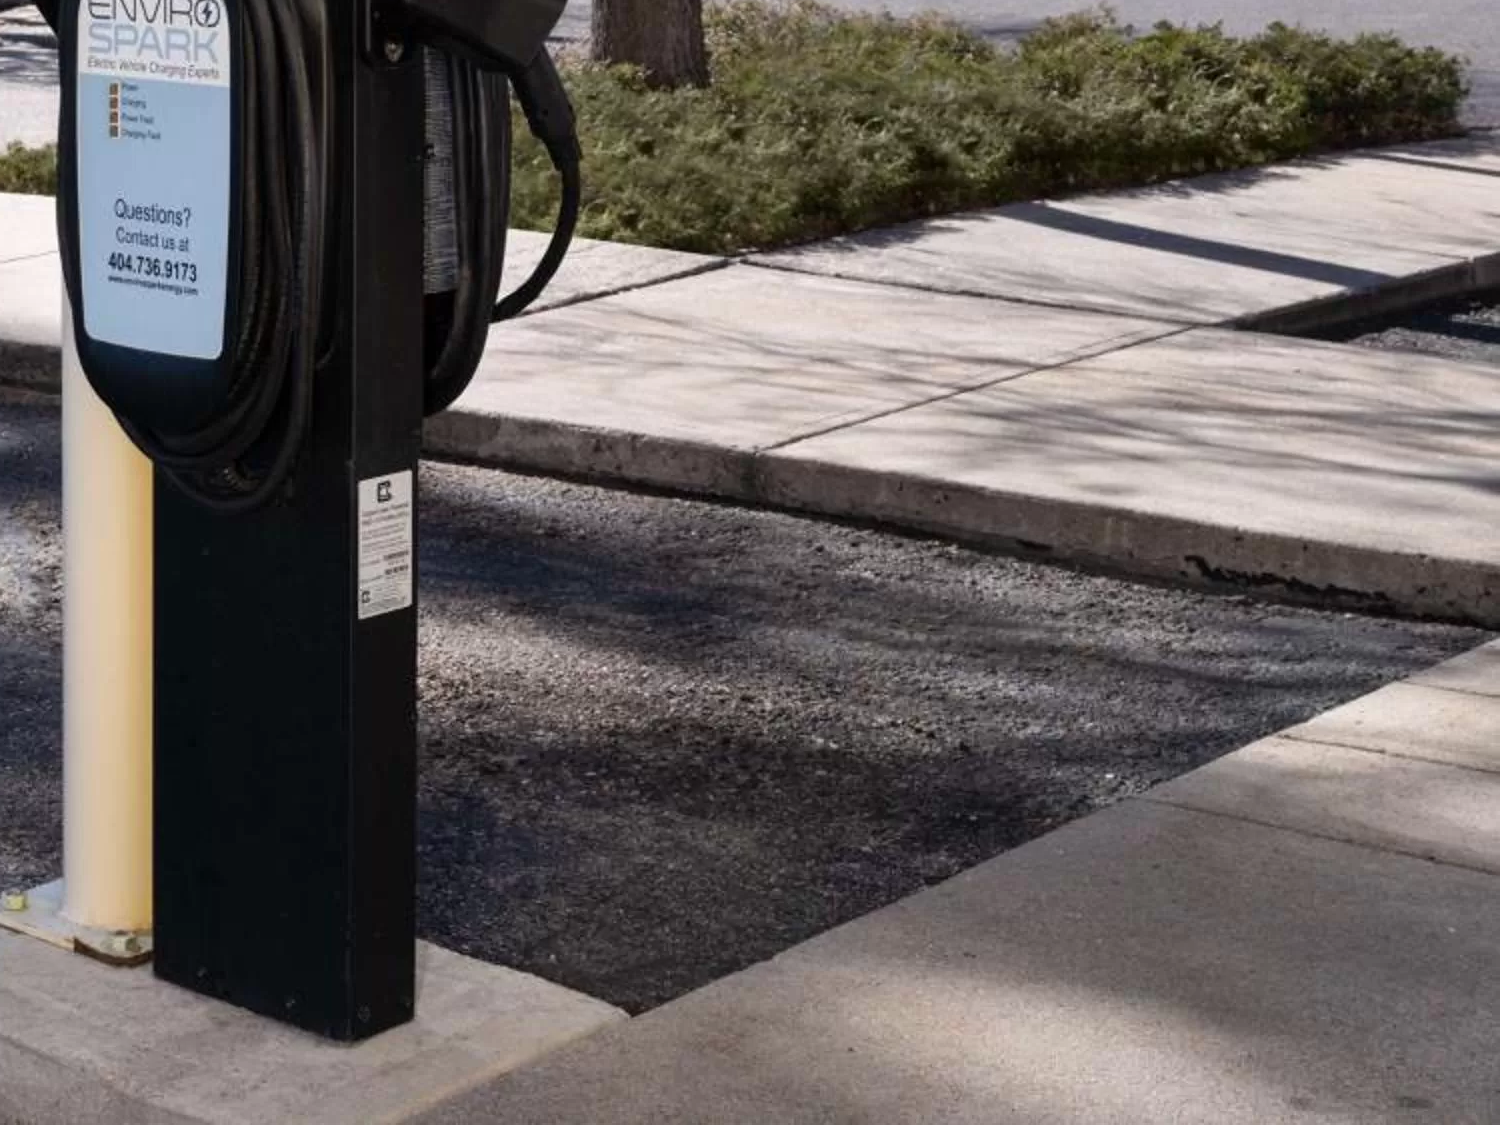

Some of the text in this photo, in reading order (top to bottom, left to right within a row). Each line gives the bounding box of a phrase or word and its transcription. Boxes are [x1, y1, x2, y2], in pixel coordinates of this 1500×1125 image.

[88, 24, 218, 64] SPARK
[114, 198, 192, 228] Questions?
[115, 226, 189, 252] Contact us at
[108, 251, 197, 283] 404.736.9173
